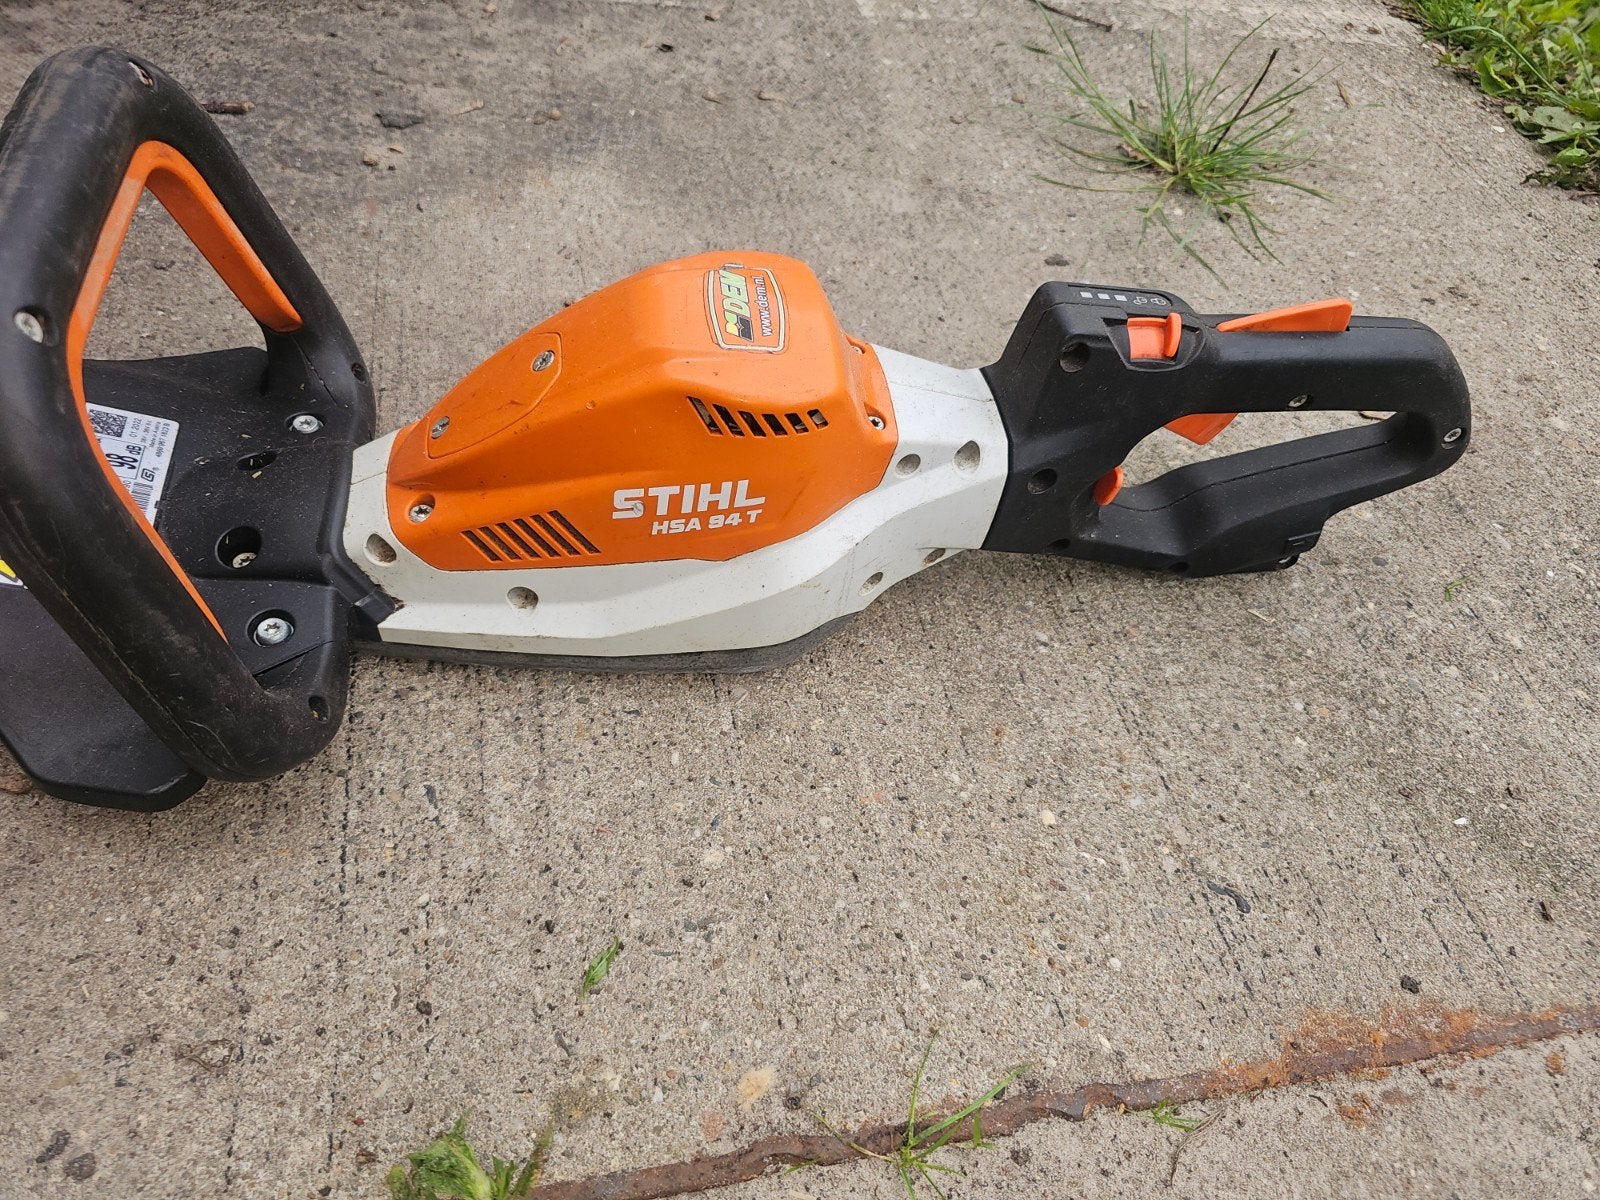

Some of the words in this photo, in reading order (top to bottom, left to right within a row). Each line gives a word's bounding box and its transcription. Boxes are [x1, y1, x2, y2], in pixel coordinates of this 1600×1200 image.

[752, 275, 773, 337] www.dem.nl
[105, 453, 139, 470] 98
[126, 444, 142, 456] dB
[612, 479, 766, 520] STIHL
[651, 517, 702, 535] HSA
[708, 512, 743, 529] 94
[746, 509, 763, 524] T
